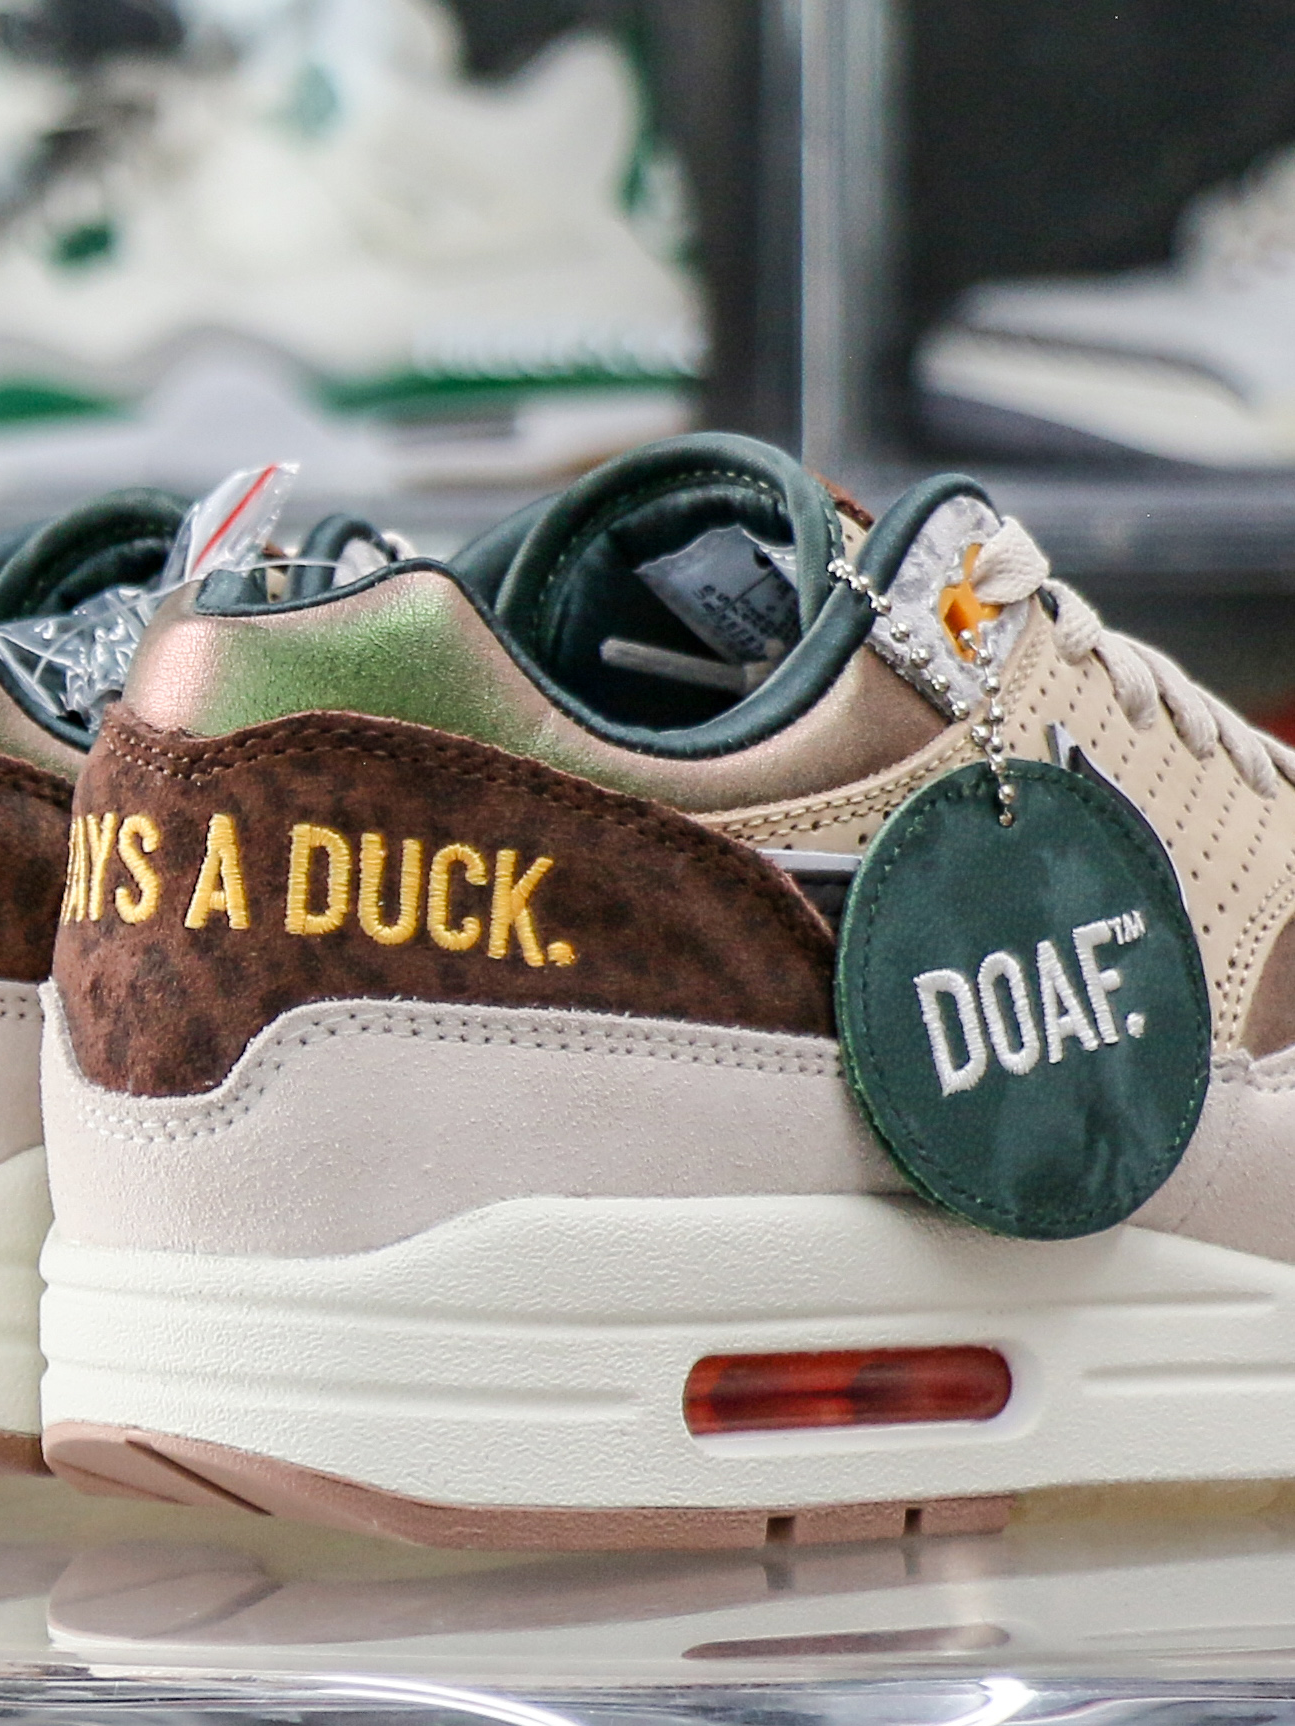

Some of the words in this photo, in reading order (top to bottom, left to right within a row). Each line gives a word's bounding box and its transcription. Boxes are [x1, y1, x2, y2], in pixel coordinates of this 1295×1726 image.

[60, 812, 160, 924] AYS
[184, 813, 251, 930] A
[285, 823, 578, 967] DUCK.
